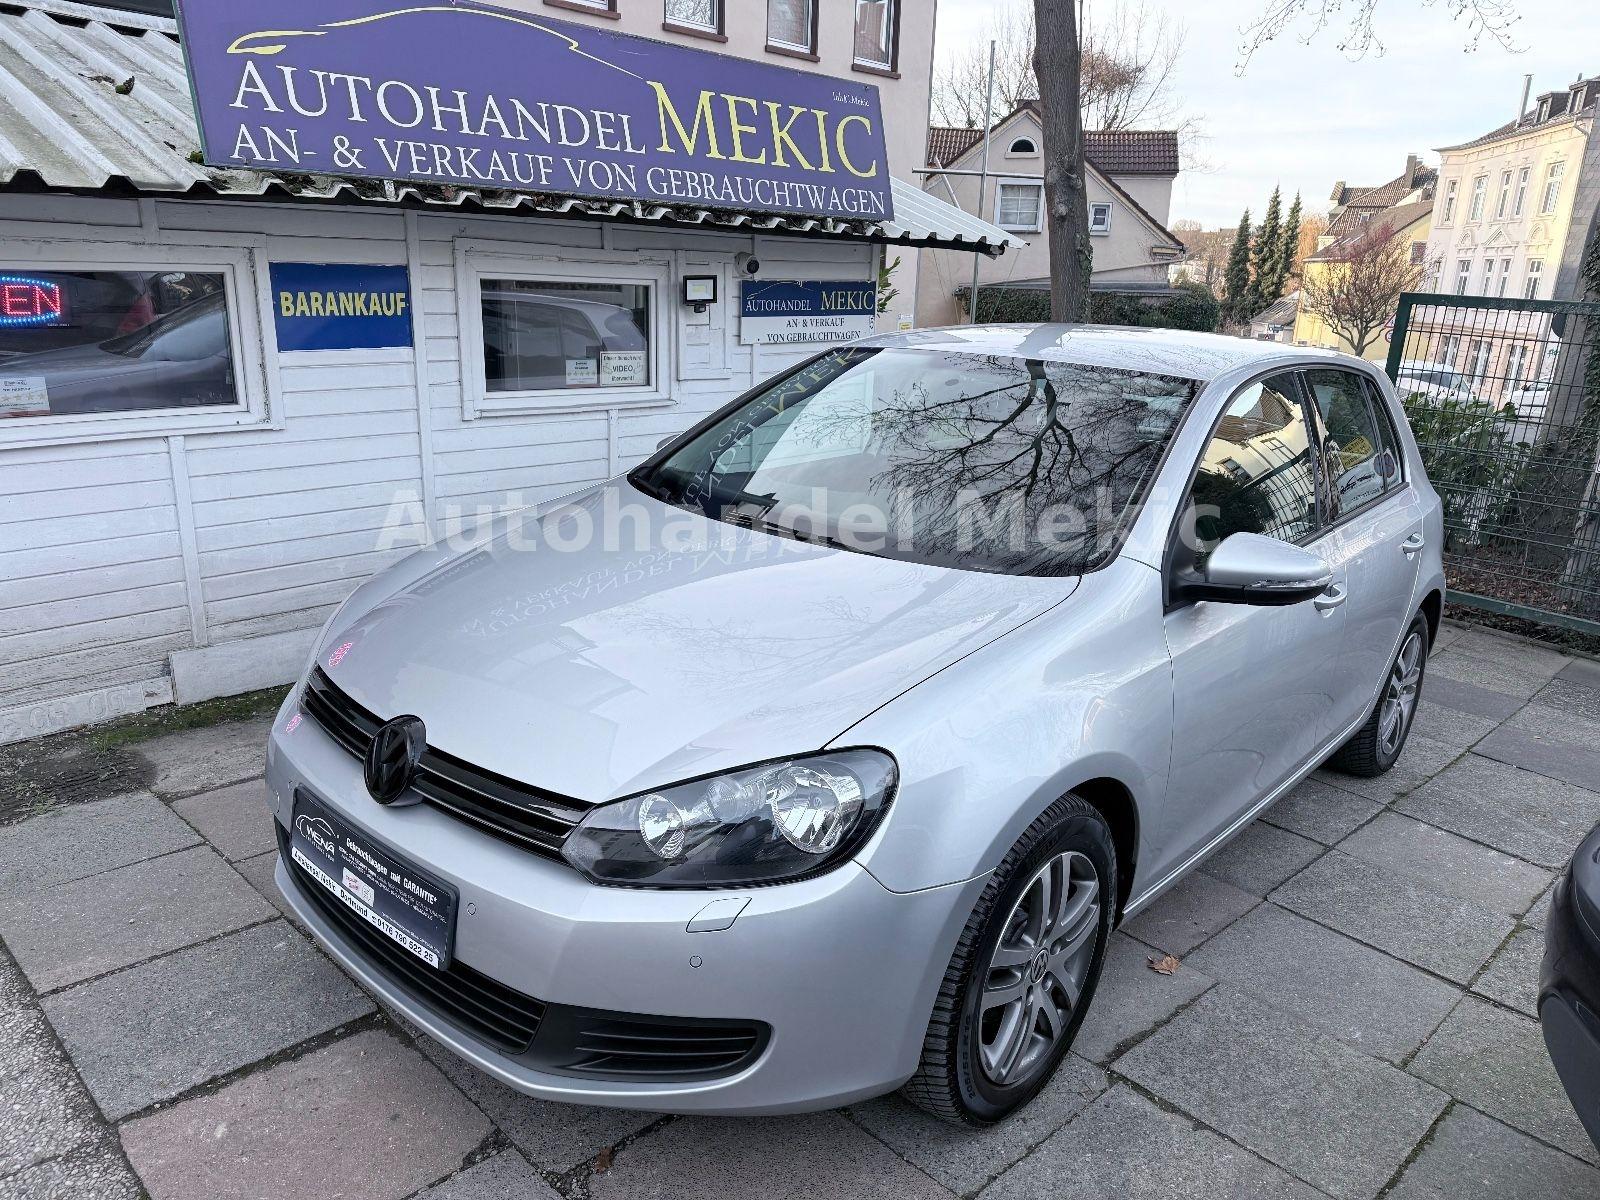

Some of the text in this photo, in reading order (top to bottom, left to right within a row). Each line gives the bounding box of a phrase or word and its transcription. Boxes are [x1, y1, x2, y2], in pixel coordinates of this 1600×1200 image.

[229, 60, 877, 178] AUTOHANDEL MEKIC
[230, 123, 886, 215] AN- & VERKAUF VON GEBRAUCHTWAGEN
[280, 291, 406, 317] BARANKAUF
[745, 290, 875, 312] AUTOHANDEL MEKIC
[786, 317, 845, 328] AN- & VERKAUF
[766, 330, 861, 342] VON GEBRAUCHTWAGEN
[612, 364, 634, 373] VIDEO
